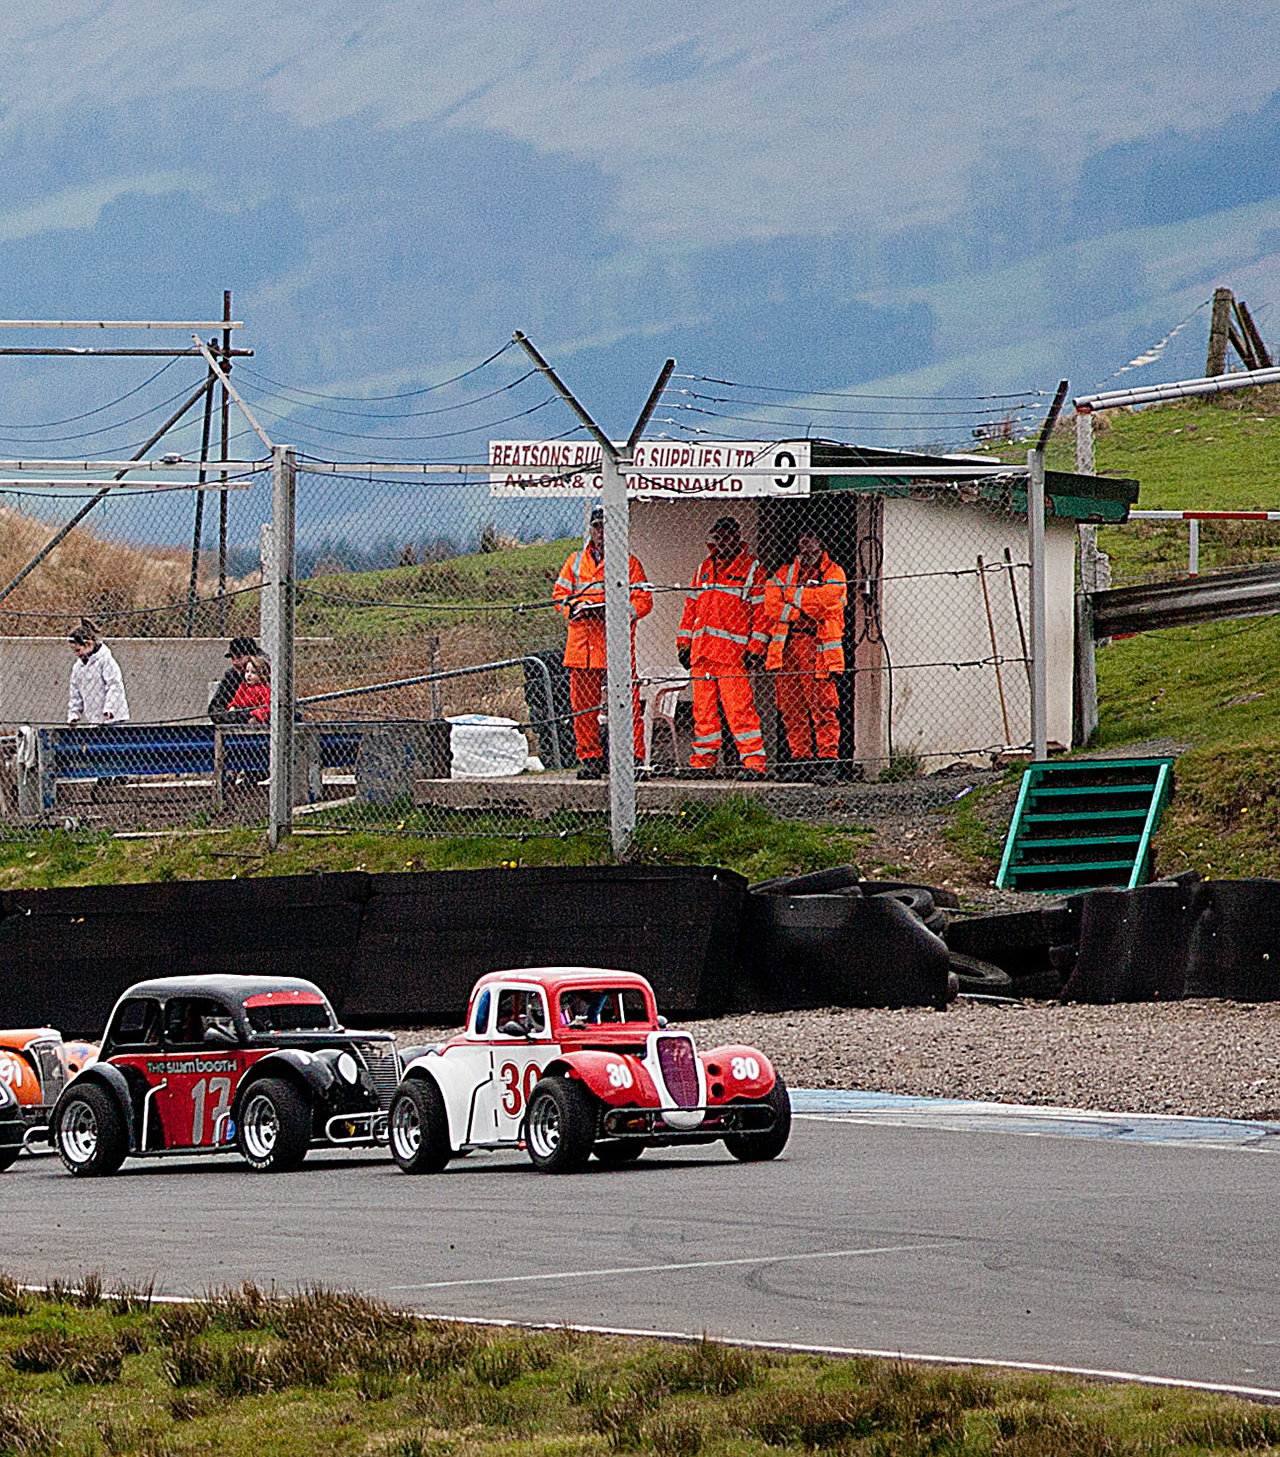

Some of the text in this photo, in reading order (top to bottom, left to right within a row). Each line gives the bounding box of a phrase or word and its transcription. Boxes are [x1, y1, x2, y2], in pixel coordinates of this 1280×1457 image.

[493, 446, 571, 466] BEATSONS
[649, 447, 721, 467] SUPPLIES
[774, 451, 797, 488] 9
[592, 474, 744, 492] CMBERNAULD
[606, 1063, 634, 1089] 30
[731, 1056, 760, 1080] 30
[500, 1059, 542, 1119] 30
[191, 1077, 232, 1145] 17
